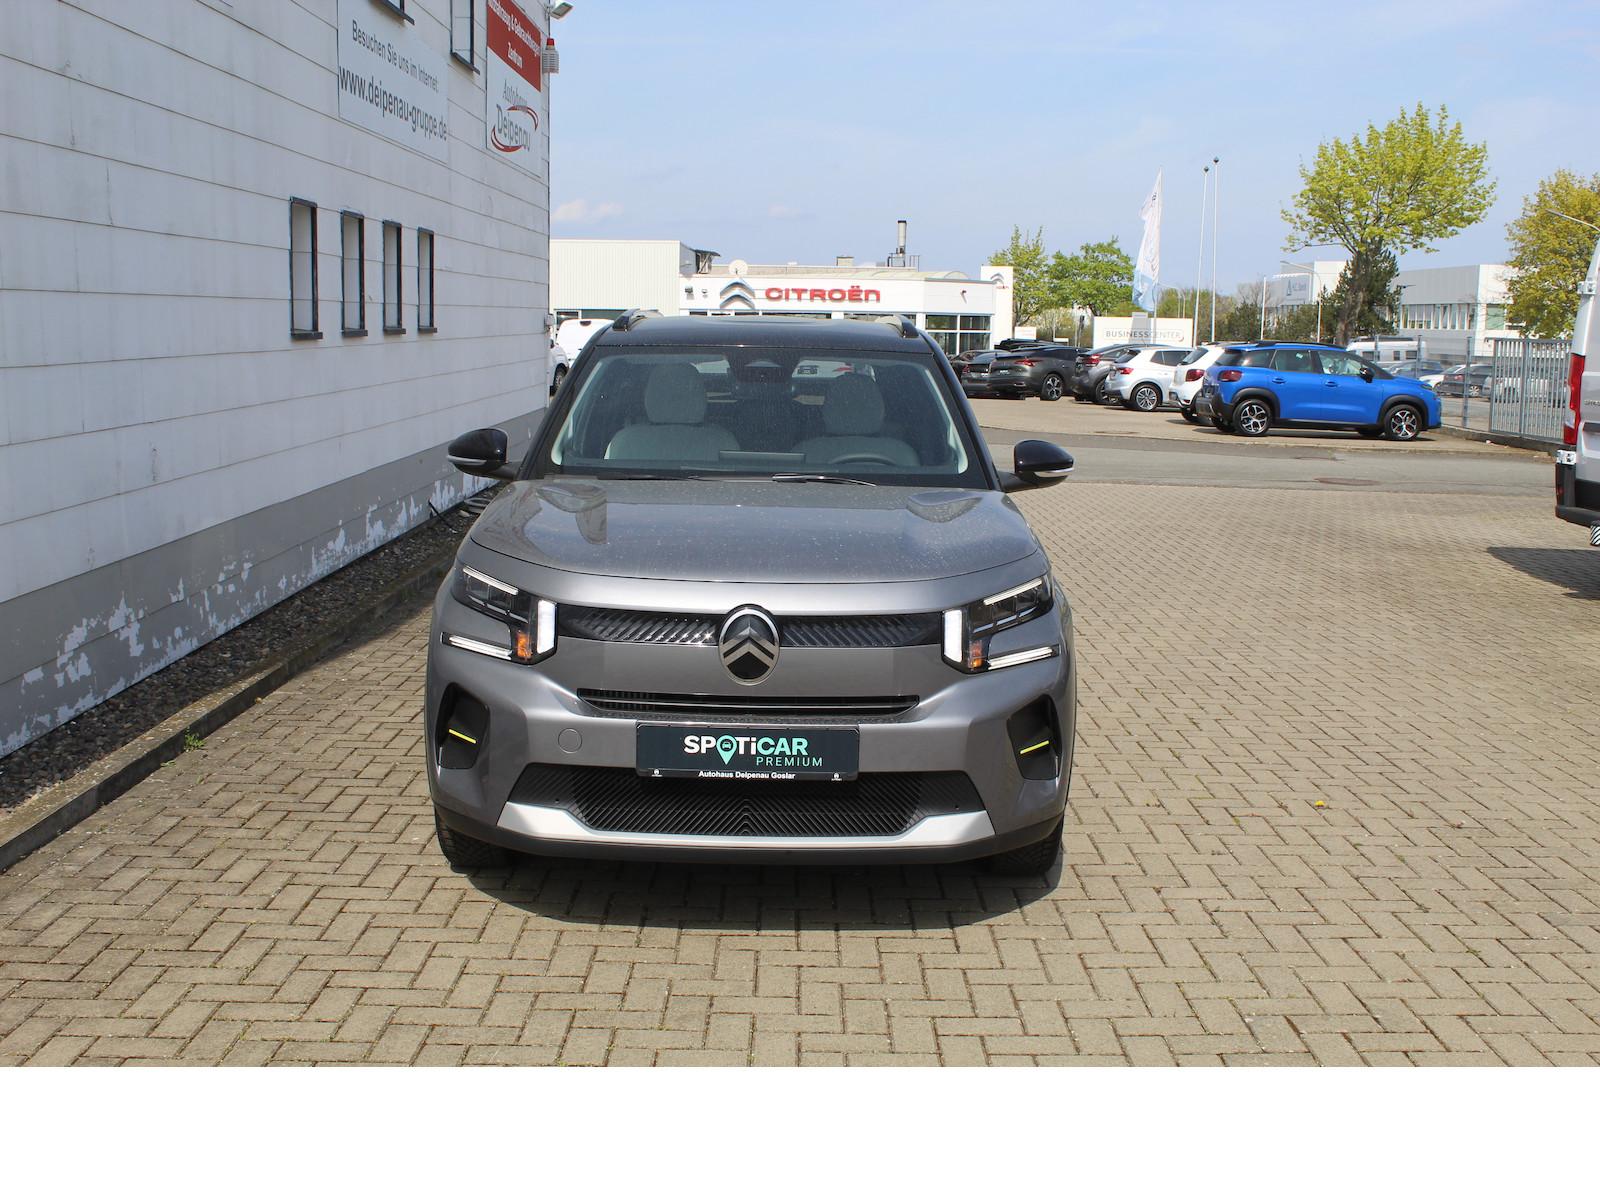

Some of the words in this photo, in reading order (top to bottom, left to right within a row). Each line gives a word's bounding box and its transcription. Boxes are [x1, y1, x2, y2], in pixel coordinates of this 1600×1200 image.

[352, 19, 386, 60] Besuchen
[387, 43, 398, 67] Sie
[399, 54, 410, 75] uns
[410, 57, 418, 79] im
[339, 65, 447, 141] www.deipenau-gruppe.de
[496, 104, 531, 152] Deipenau
[698, 770, 734, 778] Autohaus
[756, 757, 823, 767] PREMIUM
